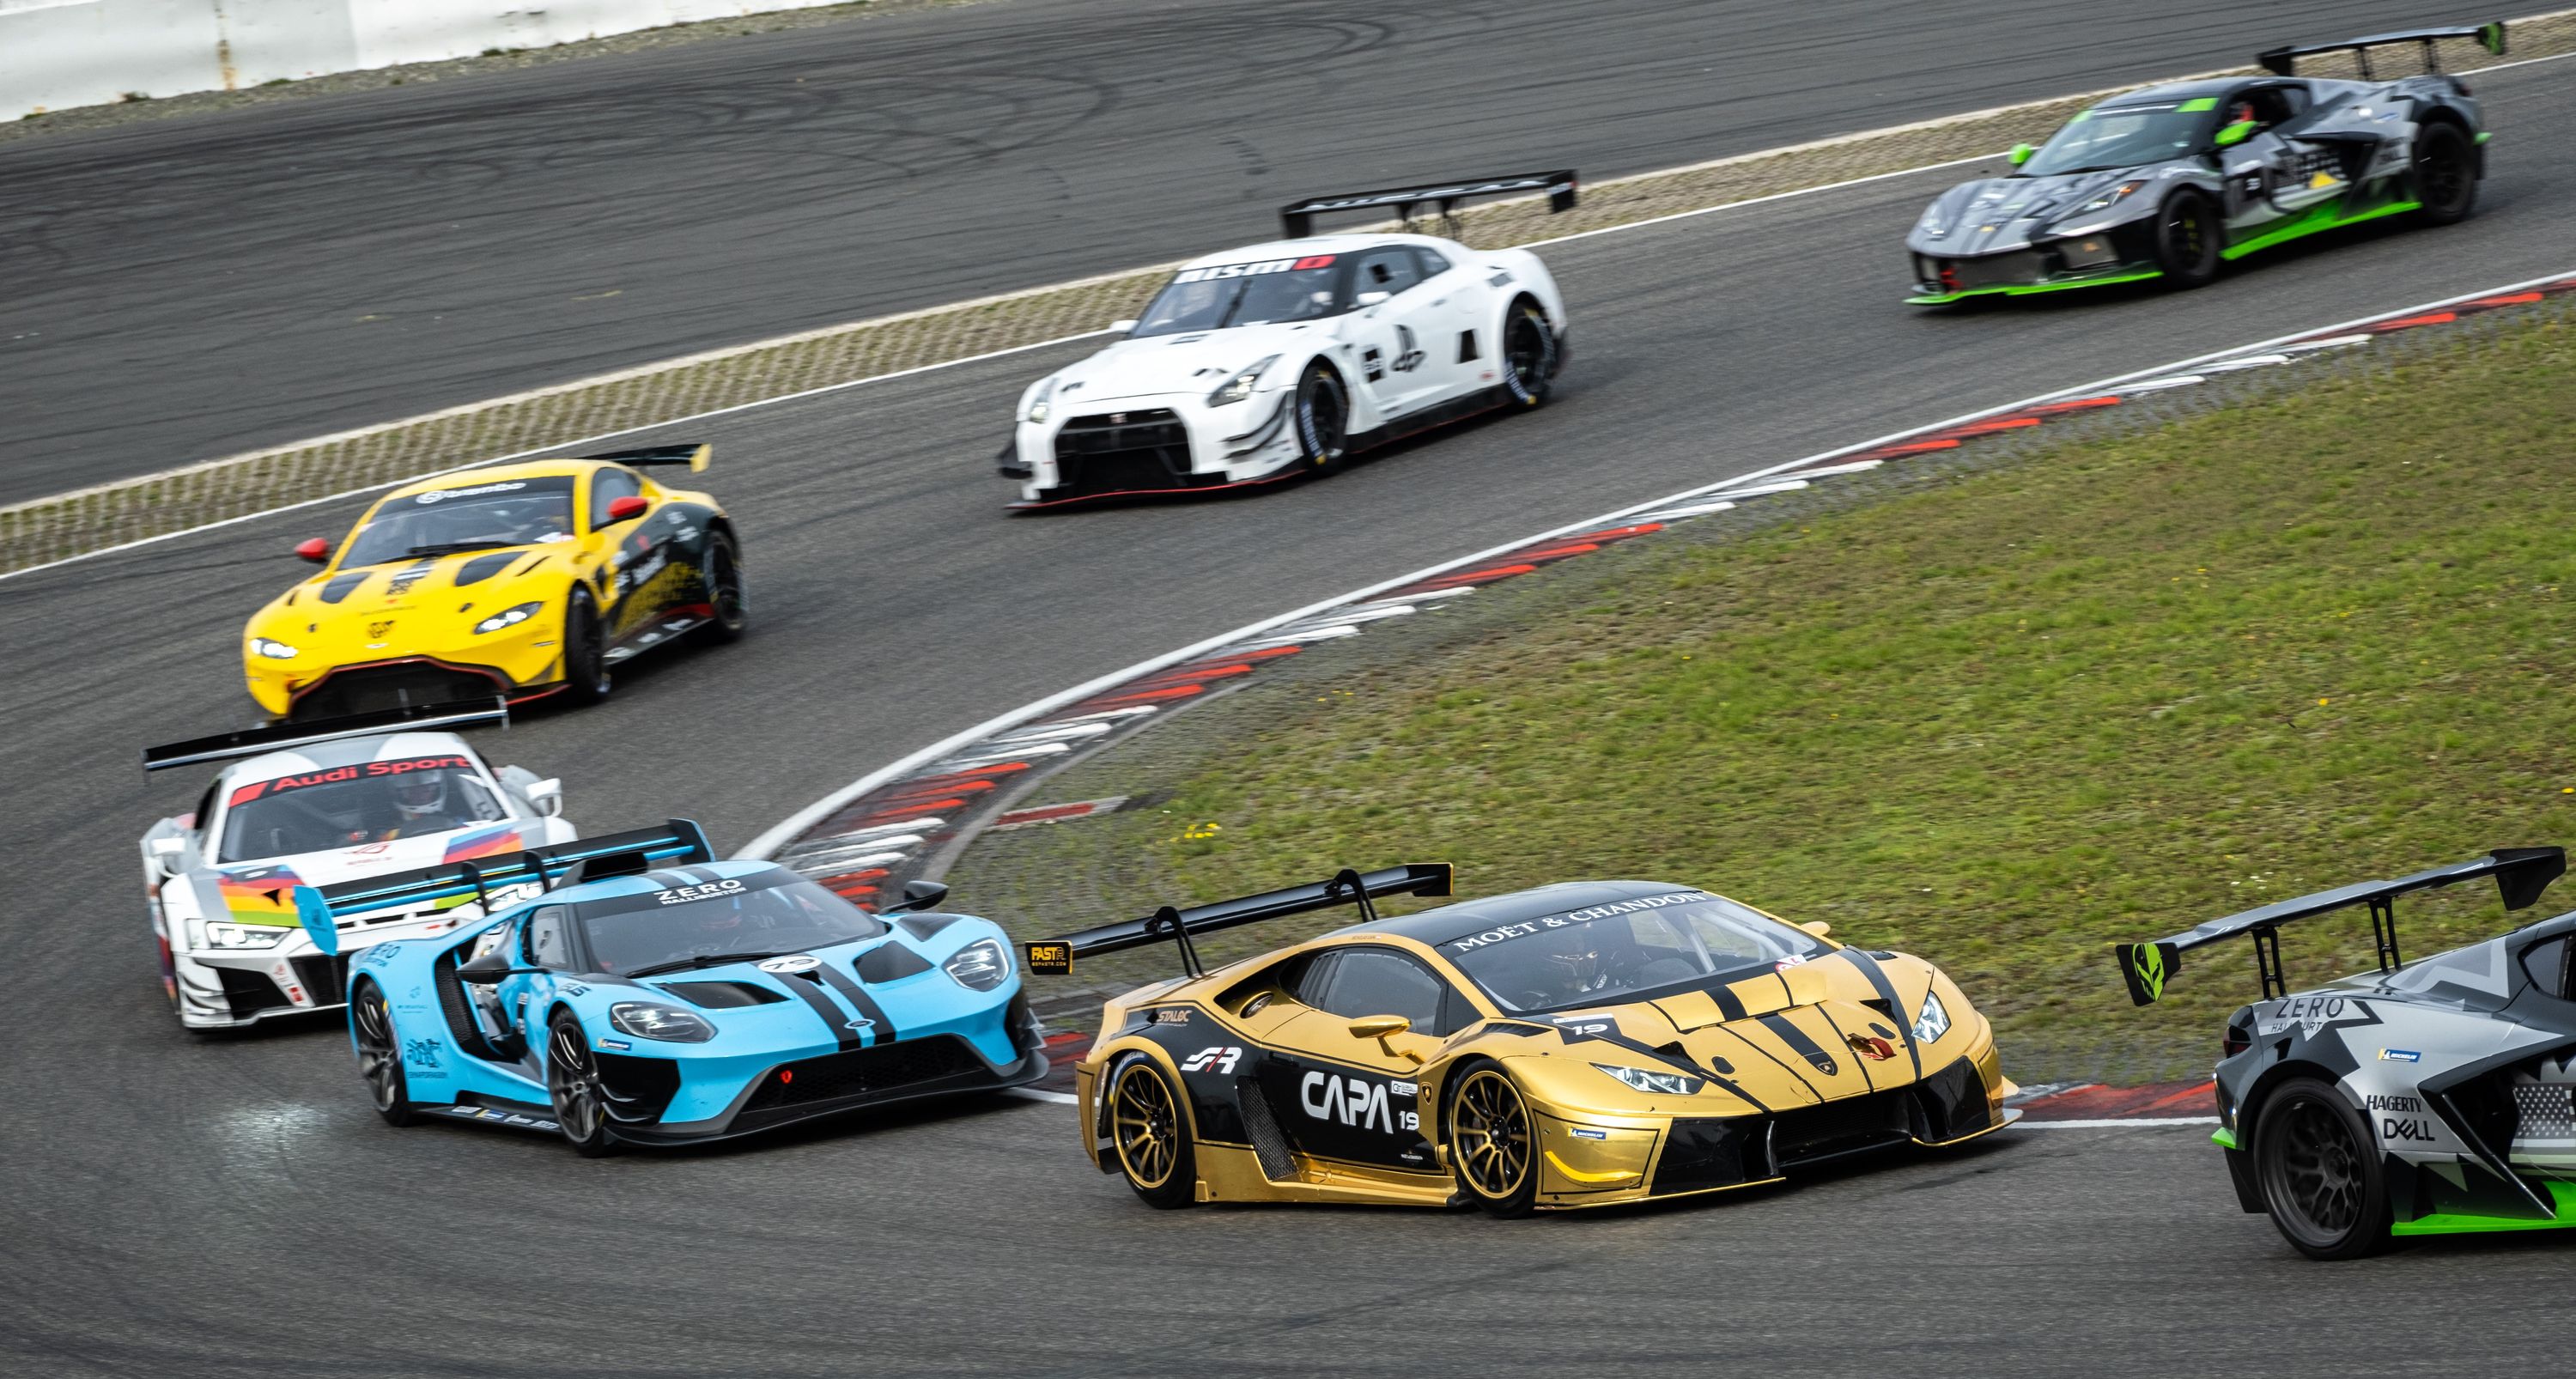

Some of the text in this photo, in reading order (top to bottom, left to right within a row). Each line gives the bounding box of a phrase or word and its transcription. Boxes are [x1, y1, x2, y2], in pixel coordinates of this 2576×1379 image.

[272, 756, 472, 792] Audi Sport
[653, 879, 742, 901] ZERO
[1452, 892, 1708, 952] MOËT & CHANDON
[1157, 1010, 1194, 1023] STALOC
[2275, 997, 2344, 1019] ZERO
[1572, 1024, 1608, 1036] 19
[1301, 1071, 1394, 1134] CAPA
[2366, 1094, 2422, 1113] HAGERTY
[1399, 1110, 1420, 1131] 19
[2384, 1118, 2436, 1142] DELL
